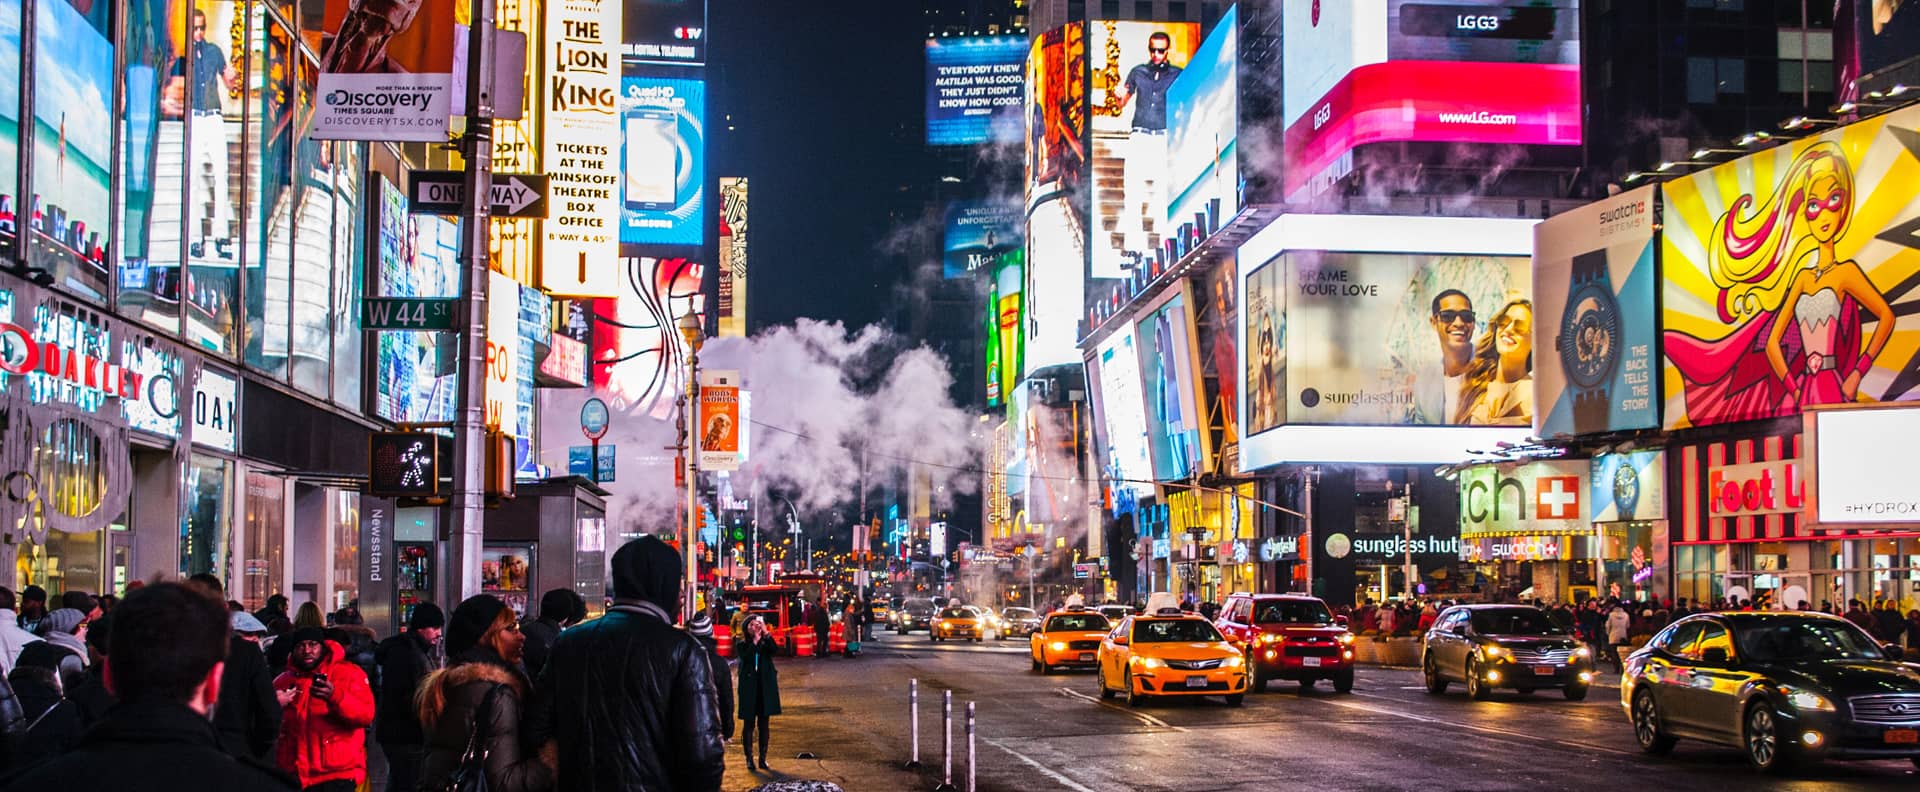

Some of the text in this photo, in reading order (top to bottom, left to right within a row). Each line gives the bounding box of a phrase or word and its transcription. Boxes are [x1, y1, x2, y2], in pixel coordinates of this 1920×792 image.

[1457, 14, 1498, 30] LG G3
[563, 20, 600, 39] THE
[556, 42, 608, 72] LION
[993, 64, 1020, 73] KNEW
[936, 77, 973, 86] MATILDA
[975, 76, 994, 84] WAS
[552, 75, 615, 112] KING
[941, 88, 963, 97] THEY
[965, 87, 986, 96] JUST
[326, 89, 432, 112] Discovery
[939, 98, 967, 108] KNOW
[969, 98, 991, 107] HOW
[334, 107, 358, 115] TIMES
[324, 116, 444, 127] DISCOVERYTSX.COM
[1439, 112, 1516, 125] www.LG.com
[557, 143, 608, 155] TICKETS
[560, 158, 604, 169] AT THE
[548, 172, 617, 185] MINSKOFF
[429, 184, 527, 204] ONE WAY
[553, 186, 609, 199] THEATRE
[567, 202, 595, 213] BOX
[1600, 203, 1637, 225] swatch
[559, 216, 604, 228] OFFICE
[1300, 269, 1348, 282] FRAME
[1299, 284, 1378, 297] YOUR LOVE
[368, 301, 447, 327] W 44 St
[1631, 345, 1648, 357] THE
[1625, 359, 1648, 371] BACK
[43, 342, 144, 402] OAKLEY
[1623, 373, 1649, 385] TELLS
[1631, 385, 1648, 397] THE
[1621, 398, 1649, 411] STORY
[1462, 470, 1527, 524] ch
[1709, 468, 1777, 513] Foot
[370, 508, 384, 582] Newsstand
[1354, 535, 1426, 557] sunglass
[1430, 535, 1458, 553] hut
[1492, 542, 1546, 557] swatch
